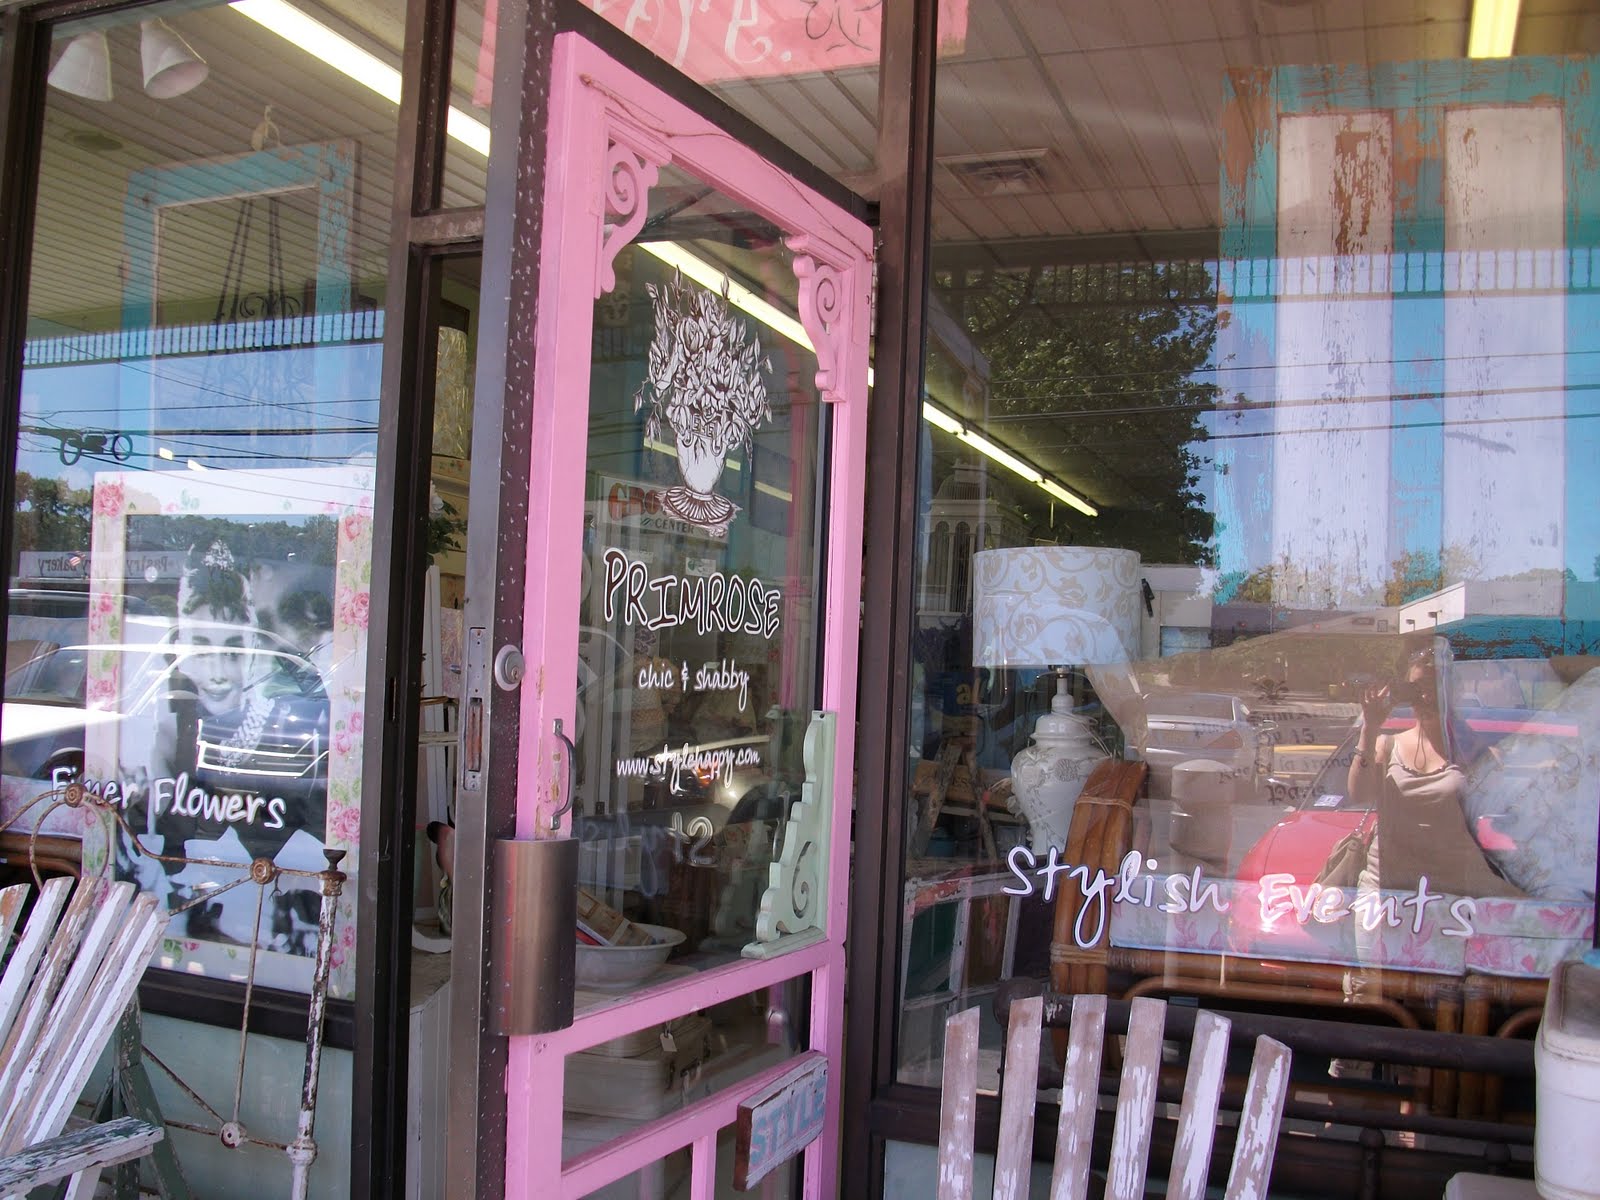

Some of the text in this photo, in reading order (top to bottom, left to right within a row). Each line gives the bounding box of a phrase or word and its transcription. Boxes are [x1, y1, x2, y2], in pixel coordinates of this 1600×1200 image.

[654, 517, 695, 535] CENTER
[603, 547, 781, 639] PRIMROSE
[638, 662, 674, 690] chic
[694, 657, 750, 713] shabby
[616, 742, 761, 795] www.stylehappy.com
[152, 771, 287, 829] Flowers
[1001, 845, 1478, 950] Stylish Events
[751, 1072, 826, 1166] STYLE
